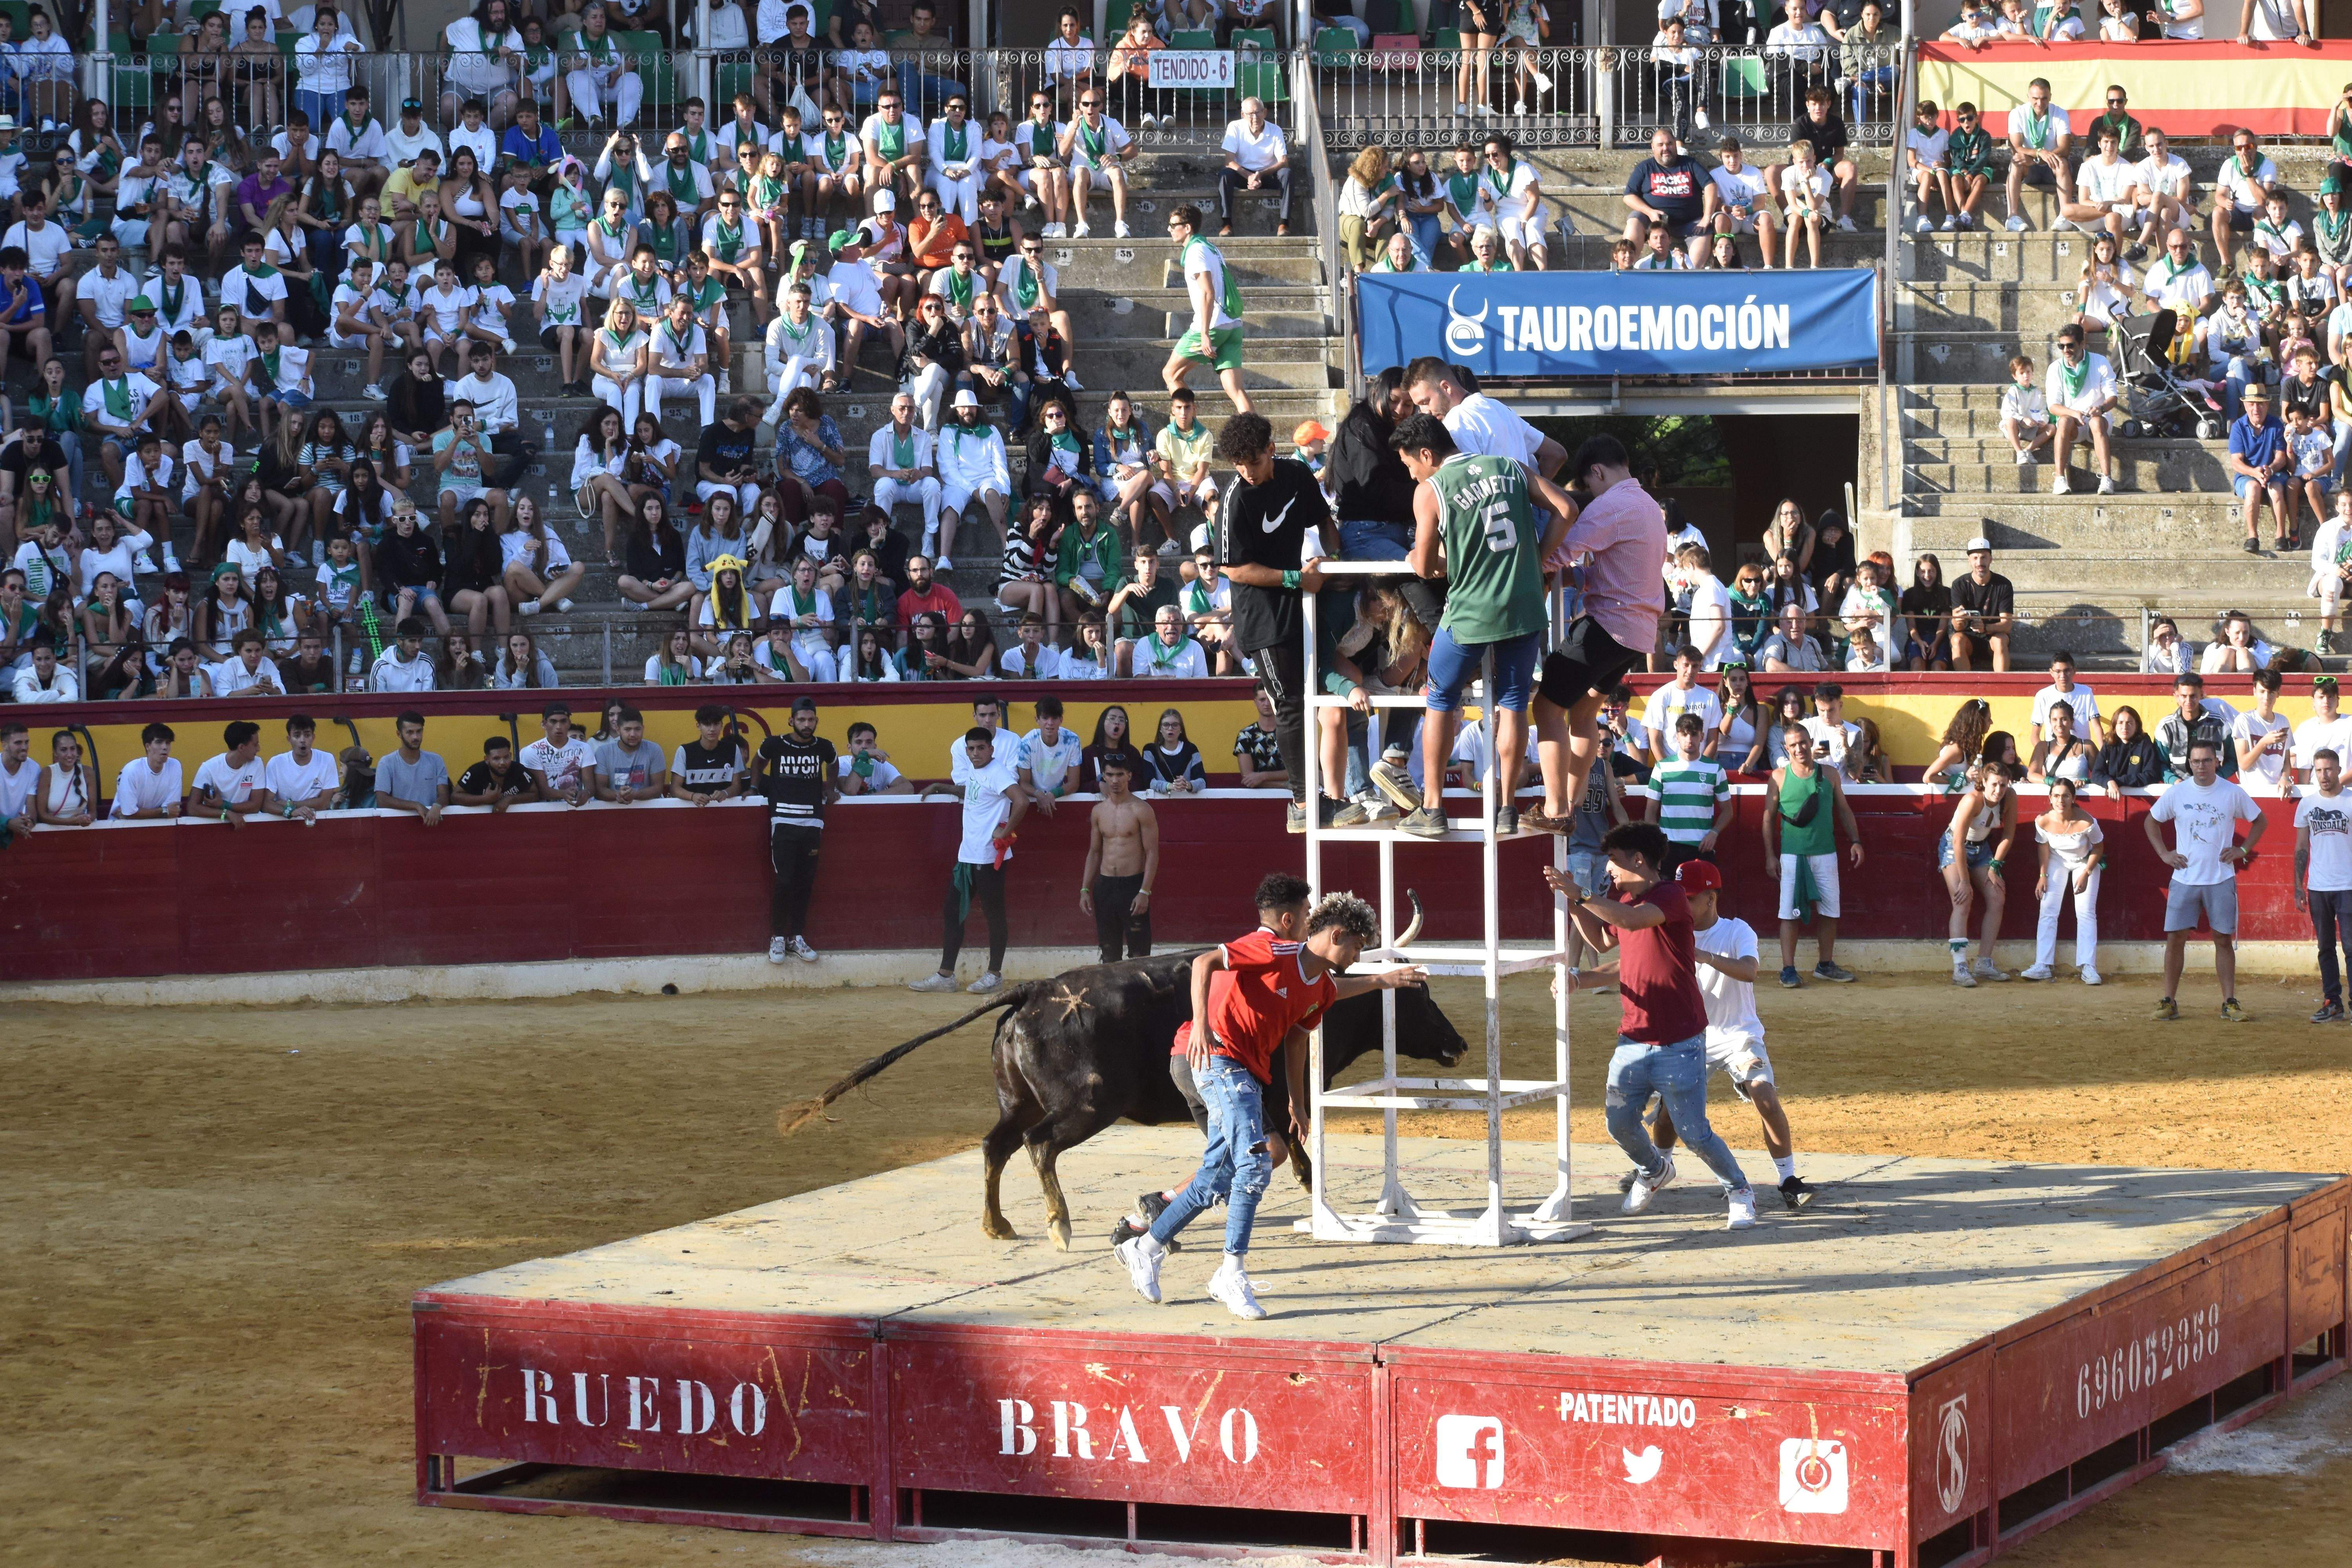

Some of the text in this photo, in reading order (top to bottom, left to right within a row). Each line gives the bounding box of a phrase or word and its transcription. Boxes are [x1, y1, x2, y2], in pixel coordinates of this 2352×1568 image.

[1154, 58, 1208, 80] TENDIDO
[1219, 55, 1227, 80] 6
[1653, 174, 1689, 185] JACK&
[1654, 185, 1690, 194] JONES
[1055, 251, 1067, 259] 34
[2060, 243, 2067, 251] 3
[1497, 294, 1789, 351] TAUROEMOCIÓN
[1453, 475, 1515, 510] GARNETT
[1479, 500, 1517, 553] 5
[461, 771, 471, 784] 2
[690, 771, 727, 781] NIKE
[2310, 818, 2347, 832] LONSDALE
[520, 1368, 766, 1436] RUEDO
[1560, 1392, 1696, 1428] PATENTADO
[997, 1398, 1259, 1464] BRAVO
